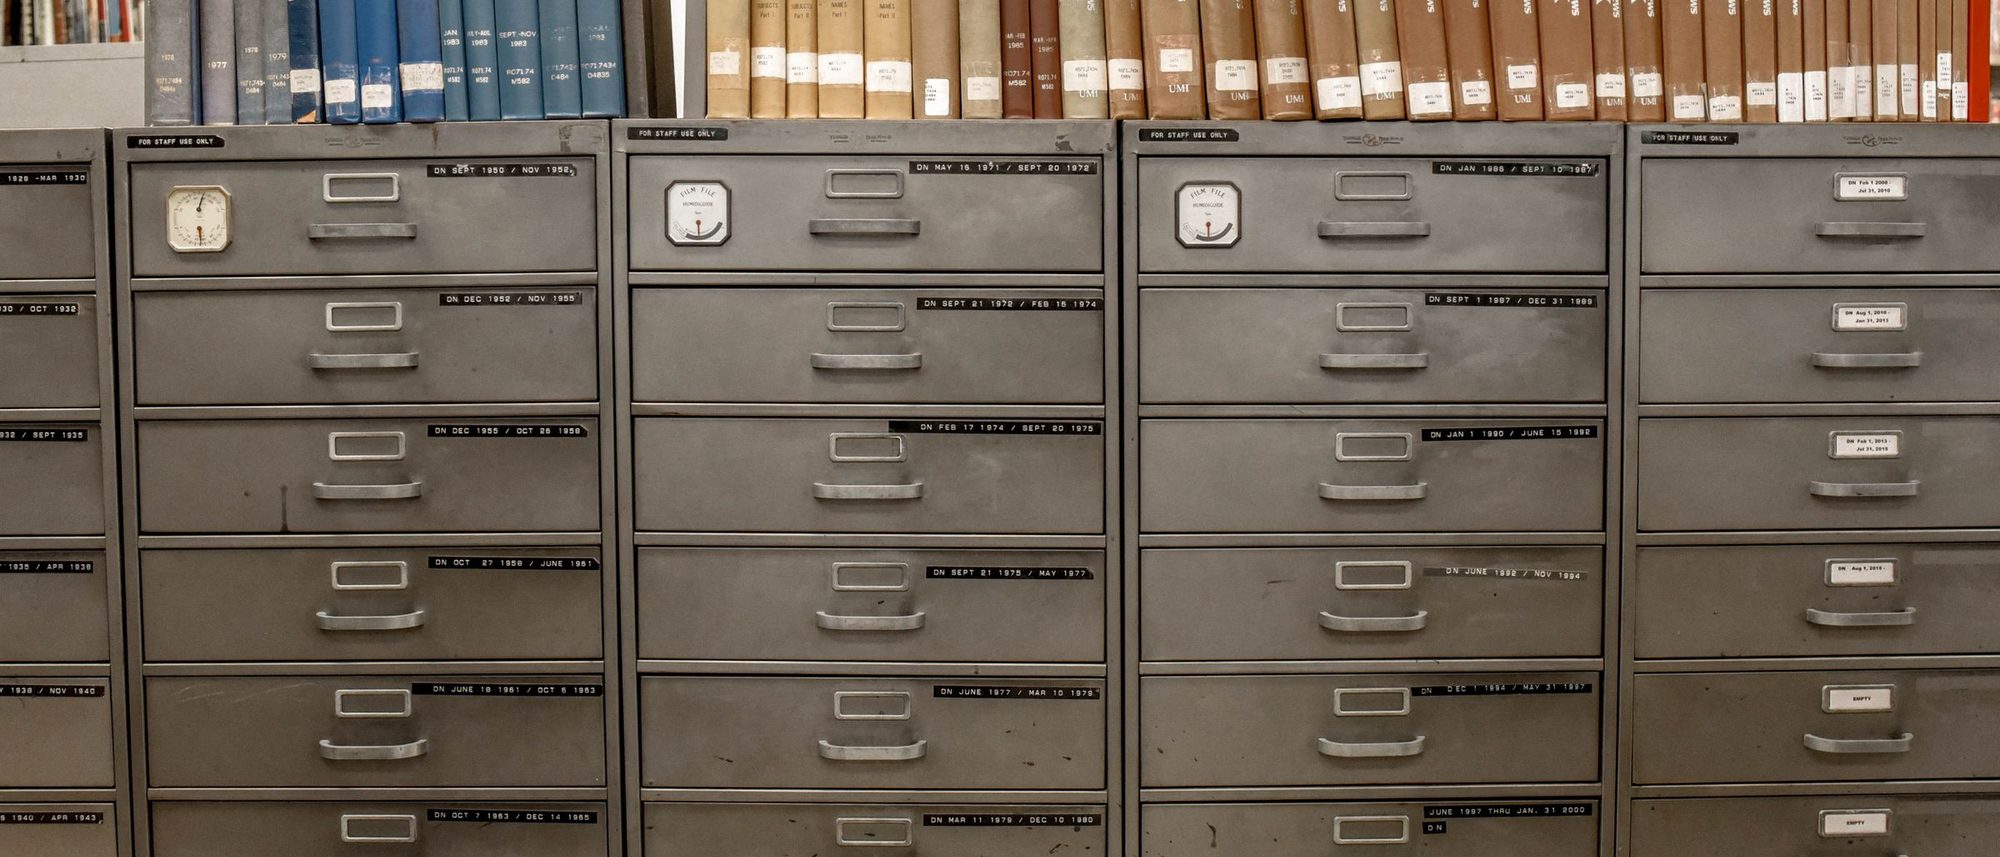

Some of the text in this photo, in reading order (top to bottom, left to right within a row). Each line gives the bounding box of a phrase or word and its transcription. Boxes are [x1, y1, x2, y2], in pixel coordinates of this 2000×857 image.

[269, 53, 287, 61] 1979
[1168, 84, 1190, 93] UMI
[1231, 92, 1249, 101] UMI
[1285, 95, 1304, 104] UMI
[1514, 95, 1532, 104] UMI
[680, 187, 716, 198] FILM FILE
[1190, 188, 1226, 199] FILM FILE
